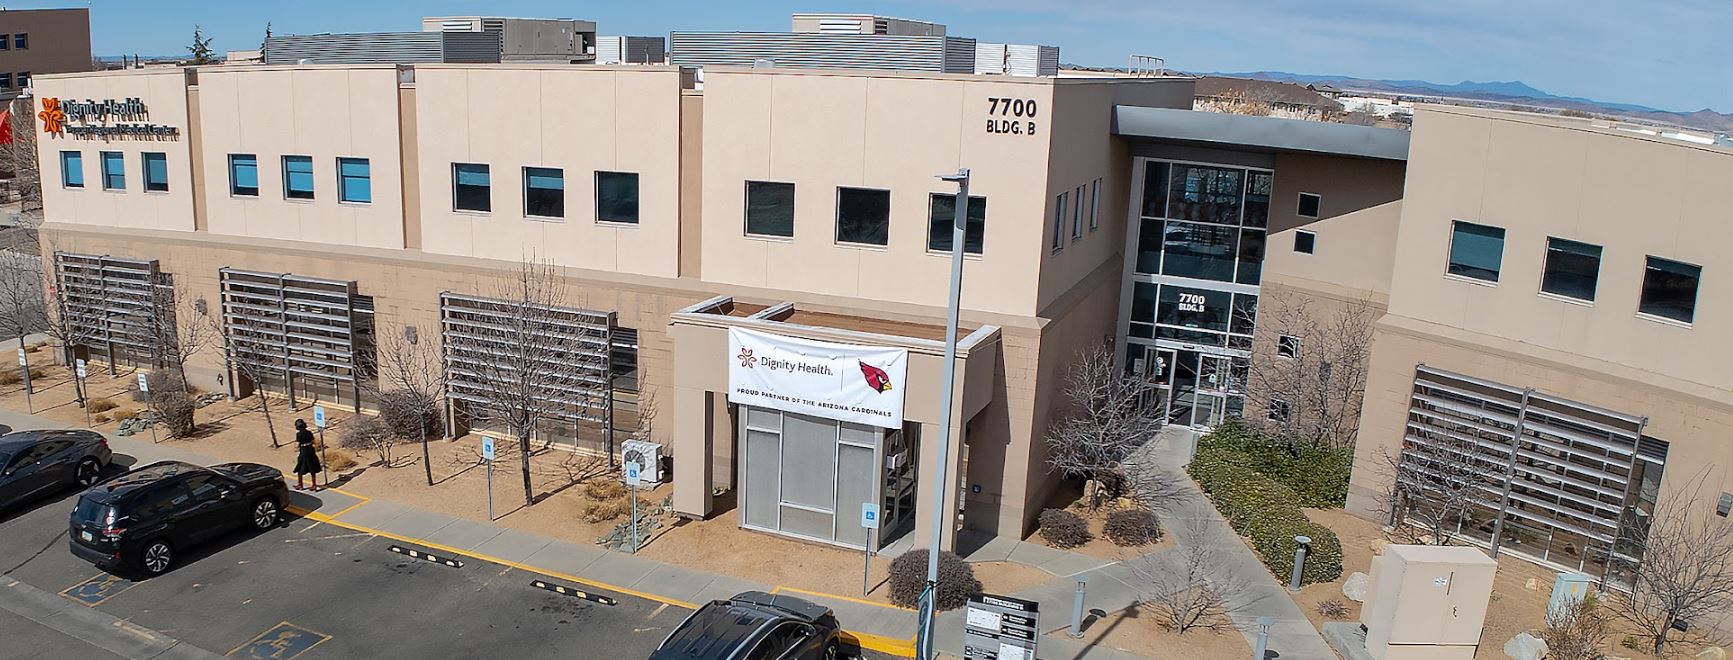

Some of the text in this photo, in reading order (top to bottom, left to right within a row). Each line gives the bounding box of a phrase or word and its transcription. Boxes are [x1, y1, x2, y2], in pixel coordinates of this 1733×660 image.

[61, 97, 144, 120] Dignity Health
[988, 97, 1037, 118] 7700
[986, 119, 1036, 136] BLDG. B
[1179, 293, 1205, 305] 7700
[1198, 304, 1205, 312] B
[761, 356, 796, 373] Dignity
[737, 388, 759, 396] PROUD
[761, 391, 790, 402] PARTNER
[803, 399, 815, 407] THE
[818, 402, 849, 411] ARIZONA
[851, 406, 892, 417] CARDINALS
